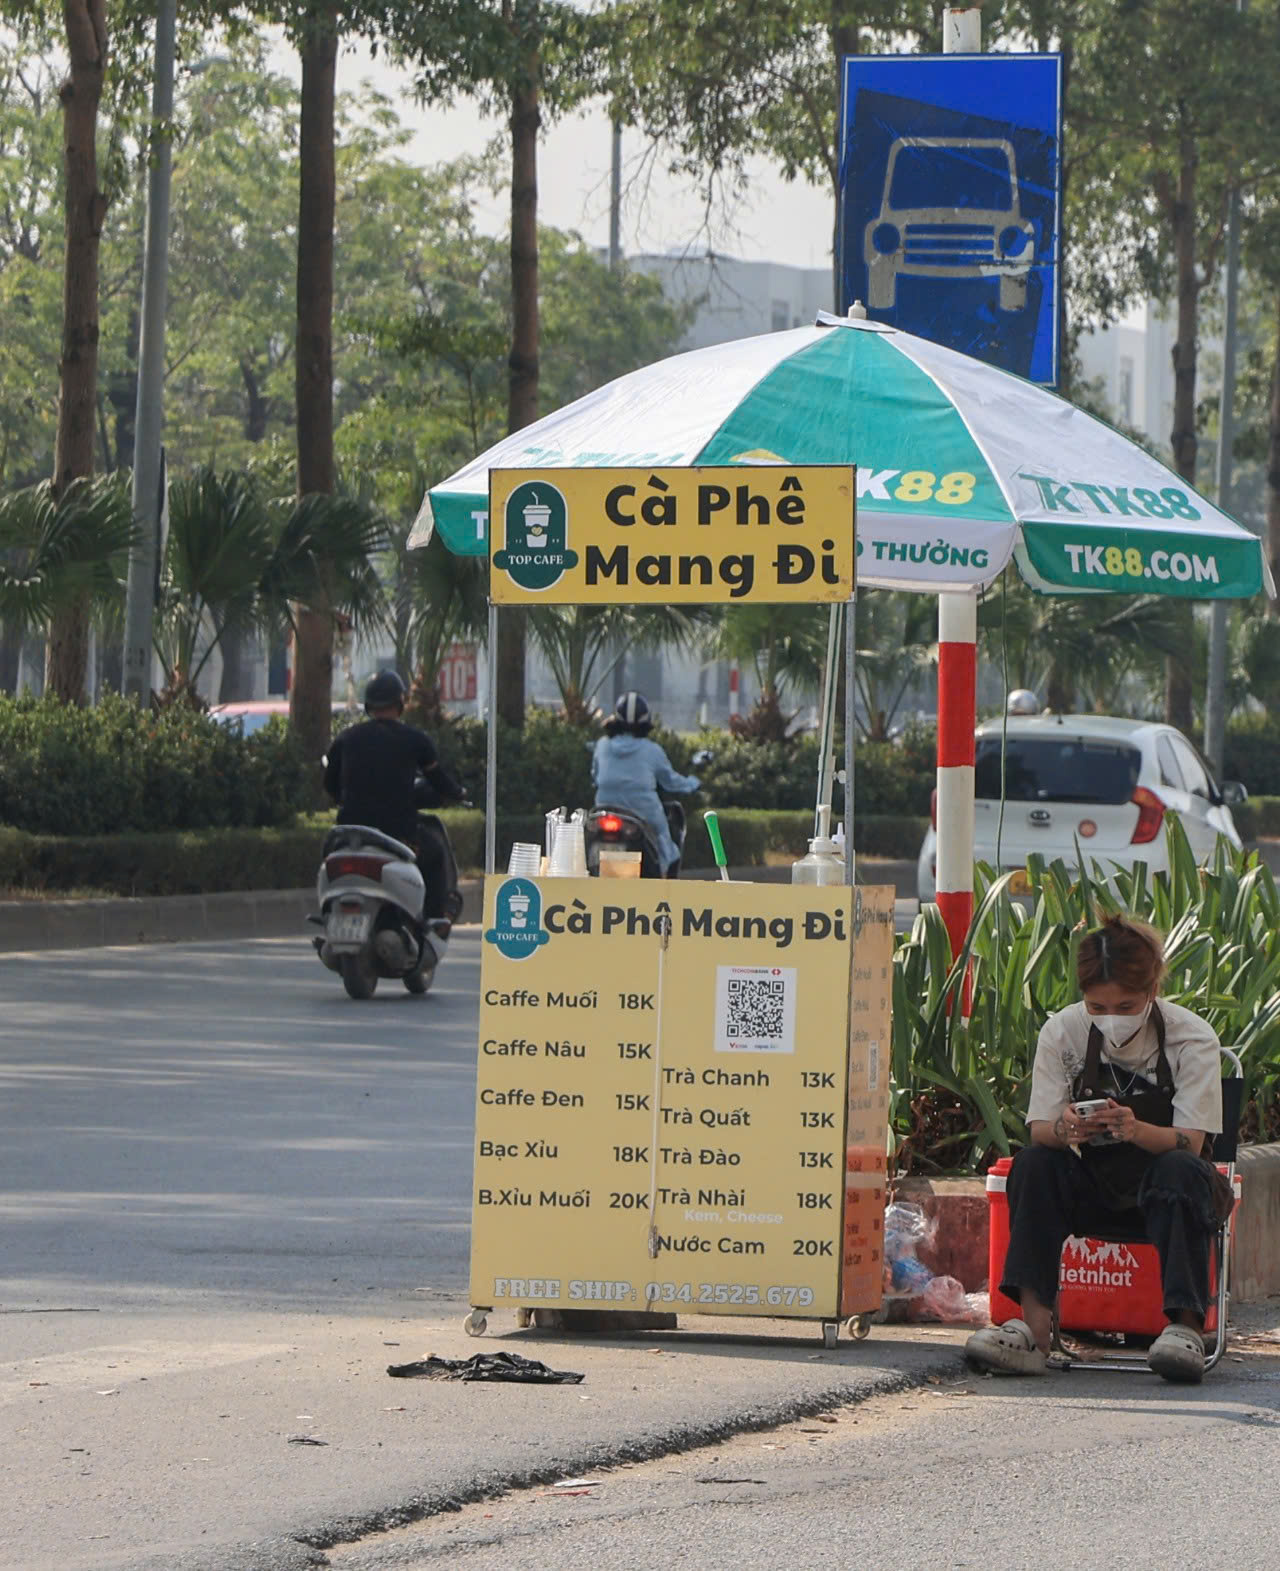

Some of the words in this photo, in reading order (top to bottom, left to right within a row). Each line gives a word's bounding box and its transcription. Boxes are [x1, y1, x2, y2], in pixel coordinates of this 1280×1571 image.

[856, 467, 977, 505] K88
[605, 474, 677, 527] Cà
[699, 475, 807, 527] Phê
[1070, 481, 1203, 522] TK88
[508, 555, 534, 565] TOP
[534, 555, 564, 565] CAFE
[871, 538, 989, 569] THƯỞNG
[1063, 543, 1220, 584] TK88.COM
[584, 544, 755, 598] Mang
[771, 539, 840, 585] Đi
[544, 898, 593, 935] Cà
[601, 902, 673, 936] Phê
[681, 908, 794, 948] Mang
[801, 909, 847, 942] Đi
[496, 932, 515, 942] TOP
[515, 932, 539, 942] CAFE
[484, 990, 540, 1007] Caffe
[546, 990, 598, 1009] Muối
[618, 993, 655, 1010] 18K
[483, 1040, 538, 1057] Caffe
[545, 1041, 586, 1058] Nâu
[617, 1043, 652, 1060] 15K
[662, 1067, 695, 1084] Trà
[701, 1069, 770, 1087] Chanh
[800, 1071, 836, 1088] 13K
[480, 1089, 536, 1106] Caffe
[541, 1090, 584, 1107] Đen
[615, 1094, 650, 1111] 15K
[660, 1107, 693, 1124] Trà
[699, 1107, 751, 1128] Quất
[800, 1111, 835, 1129] 13K
[479, 1140, 519, 1161] Bạc
[524, 1140, 559, 1158] Xỉu
[613, 1146, 649, 1163] 18K
[659, 1147, 692, 1165] Trà
[698, 1148, 741, 1166] Đào
[798, 1151, 834, 1168] 13K
[478, 1187, 532, 1206] B.Xỉu
[539, 1188, 591, 1208] Muối
[609, 1192, 650, 1210] 20K
[657, 1188, 691, 1205] Trà
[698, 1189, 745, 1207] Nhài
[796, 1192, 833, 1210] 18K
[683, 1209, 723, 1224] Kem,
[727, 1209, 784, 1225] Cheese
[657, 1235, 712, 1253] Nước
[717, 1237, 766, 1255] Cam
[792, 1239, 833, 1257] 20K
[1059, 1263, 1133, 1287] ietnhat
[494, 1278, 561, 1299] FREE
[568, 1279, 637, 1301] SHIP:
[645, 1283, 815, 1307] 034.2525.679
